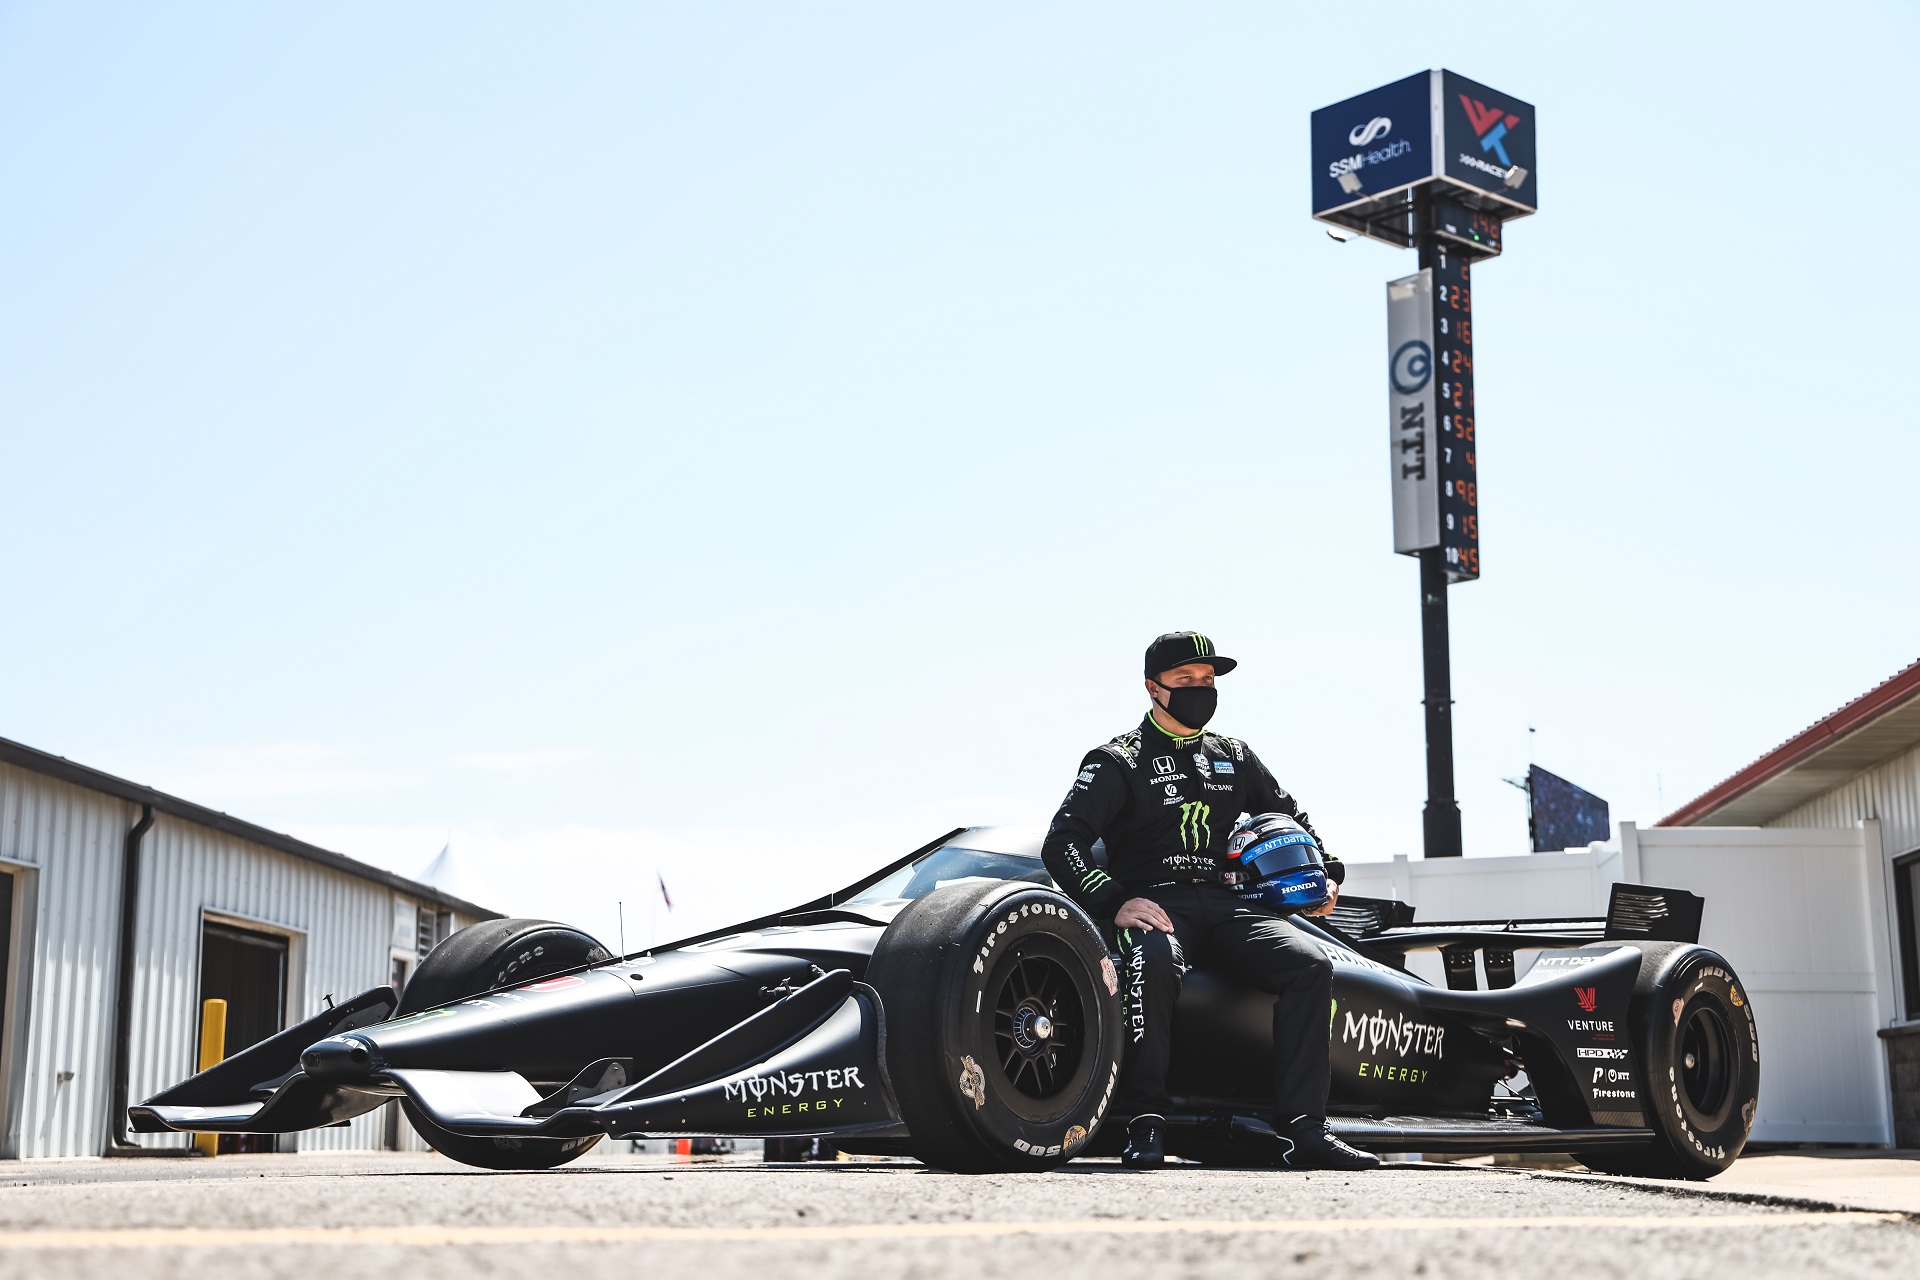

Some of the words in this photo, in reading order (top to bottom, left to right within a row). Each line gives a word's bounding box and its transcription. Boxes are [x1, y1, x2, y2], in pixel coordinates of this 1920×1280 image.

[1439, 253, 1447, 269] 1
[1439, 285, 1448, 302] 2
[1450, 285, 1471, 313] 23
[1440, 317, 1449, 334] 3
[1456, 320, 1472, 345] 16
[1441, 350, 1450, 366] 4
[1452, 349, 1473, 374] 24
[1442, 382, 1451, 399] 5
[1443, 415, 1452, 432] 6
[1401, 402, 1427, 481] NTT
[1444, 448, 1452, 464] 7
[1465, 451, 1476, 472] 4
[1445, 480, 1454, 498] 8
[1455, 479, 1477, 507] 98
[1446, 513, 1455, 531] 9
[1462, 515, 1478, 539] 15
[1445, 546, 1459, 565] 10
[1457, 547, 1479, 573] 45
[1149, 773, 1188, 785] HONDA
[1264, 838, 1283, 851] NTT
[1281, 881, 1318, 895] HONDA
[973, 903, 1069, 974] Firestone
[1536, 957, 1568, 967] NTT
[1698, 965, 1733, 984] INDY
[1342, 1009, 1445, 1060] MONSTER
[1567, 1019, 1615, 1032] VENTURE
[1743, 1003, 1758, 1063] 500
[1578, 1048, 1604, 1057] HPD
[1358, 1062, 1428, 1083] ENERGY
[1617, 1071, 1630, 1081] NTT
[722, 1066, 865, 1103] MONSTER
[1592, 1088, 1636, 1099] Firestone
[1087, 1060, 1118, 1134] INDY
[747, 1098, 844, 1118] ENERGY
[1669, 1066, 1726, 1160] Firestone
[1013, 1138, 1062, 1157] 500
